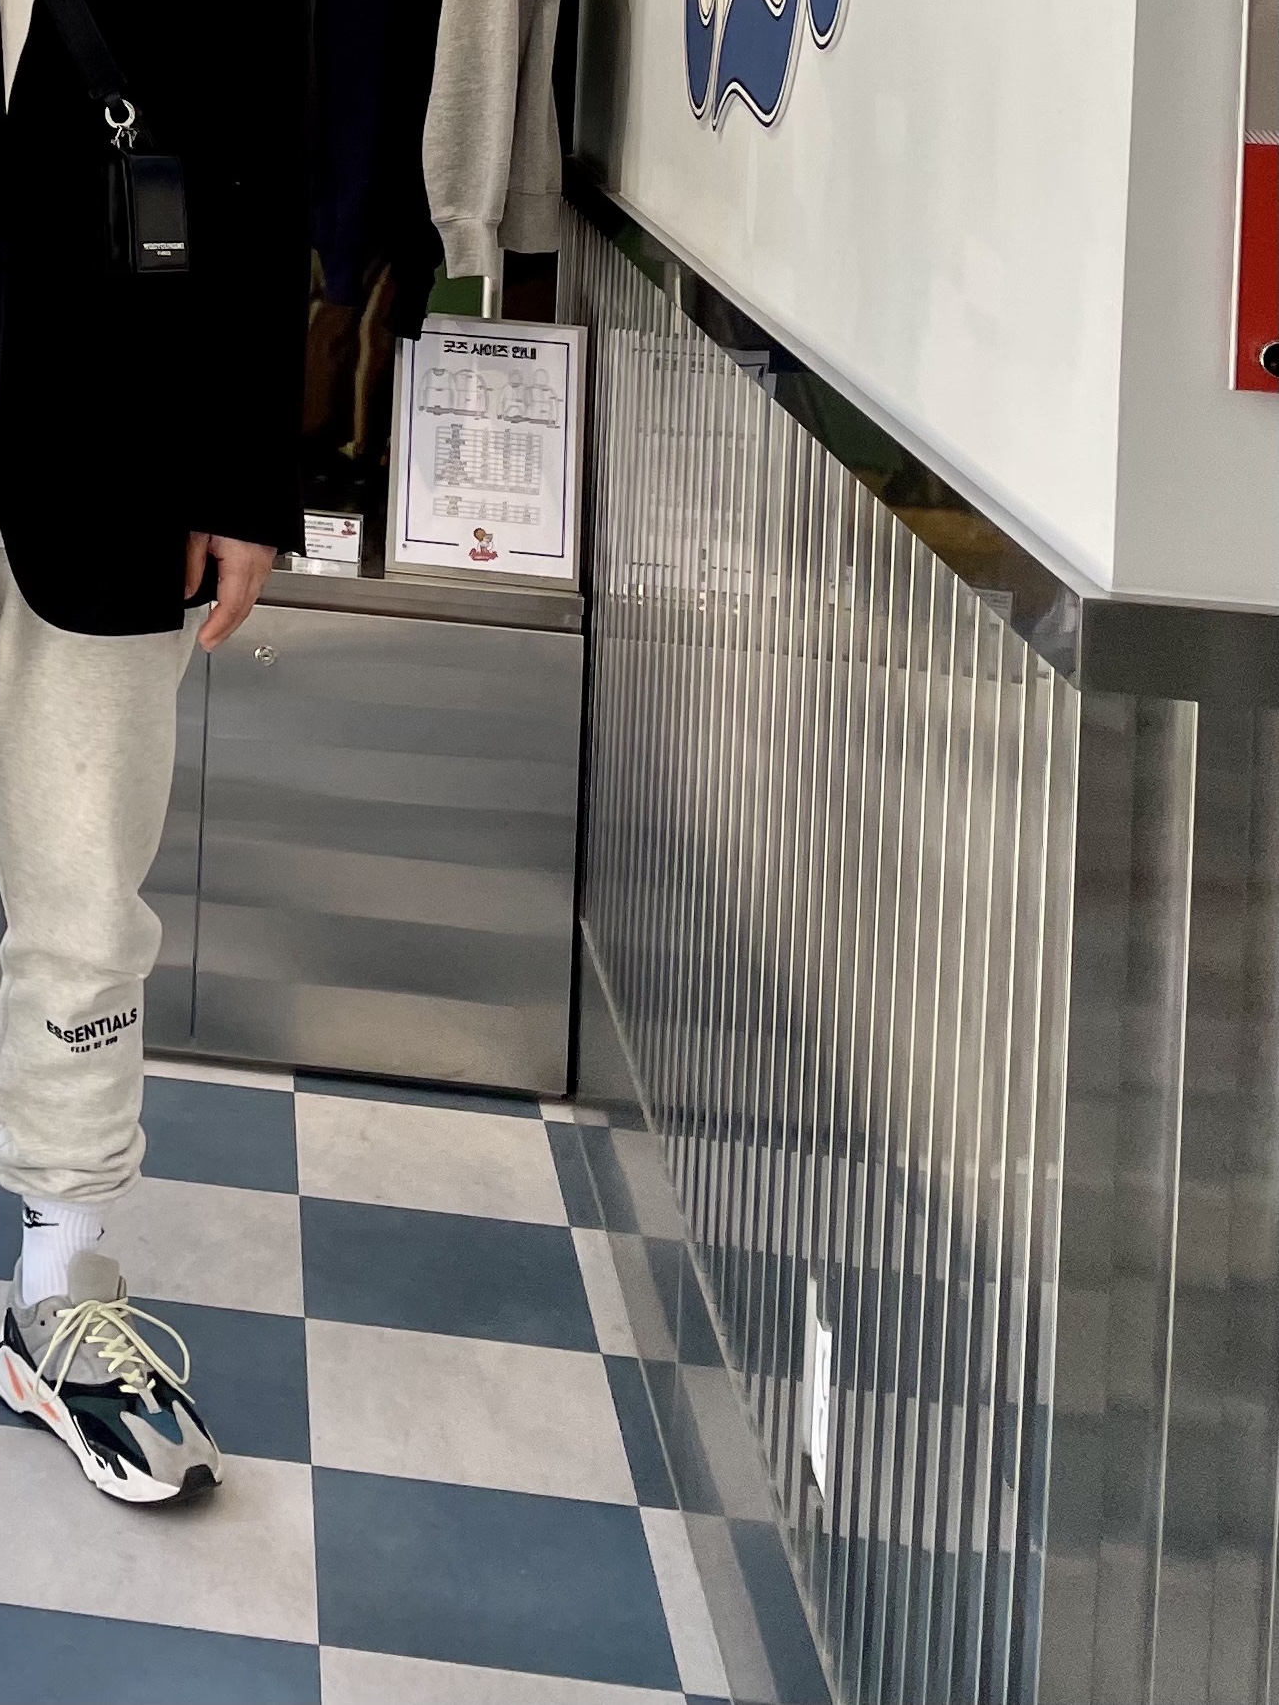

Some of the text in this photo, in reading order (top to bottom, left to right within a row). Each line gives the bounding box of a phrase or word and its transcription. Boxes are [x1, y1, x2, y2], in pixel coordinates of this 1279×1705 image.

[443, 339, 537, 360] 굿즈 사이즈 안내
[46, 1007, 138, 1044] ESSENTIALS
